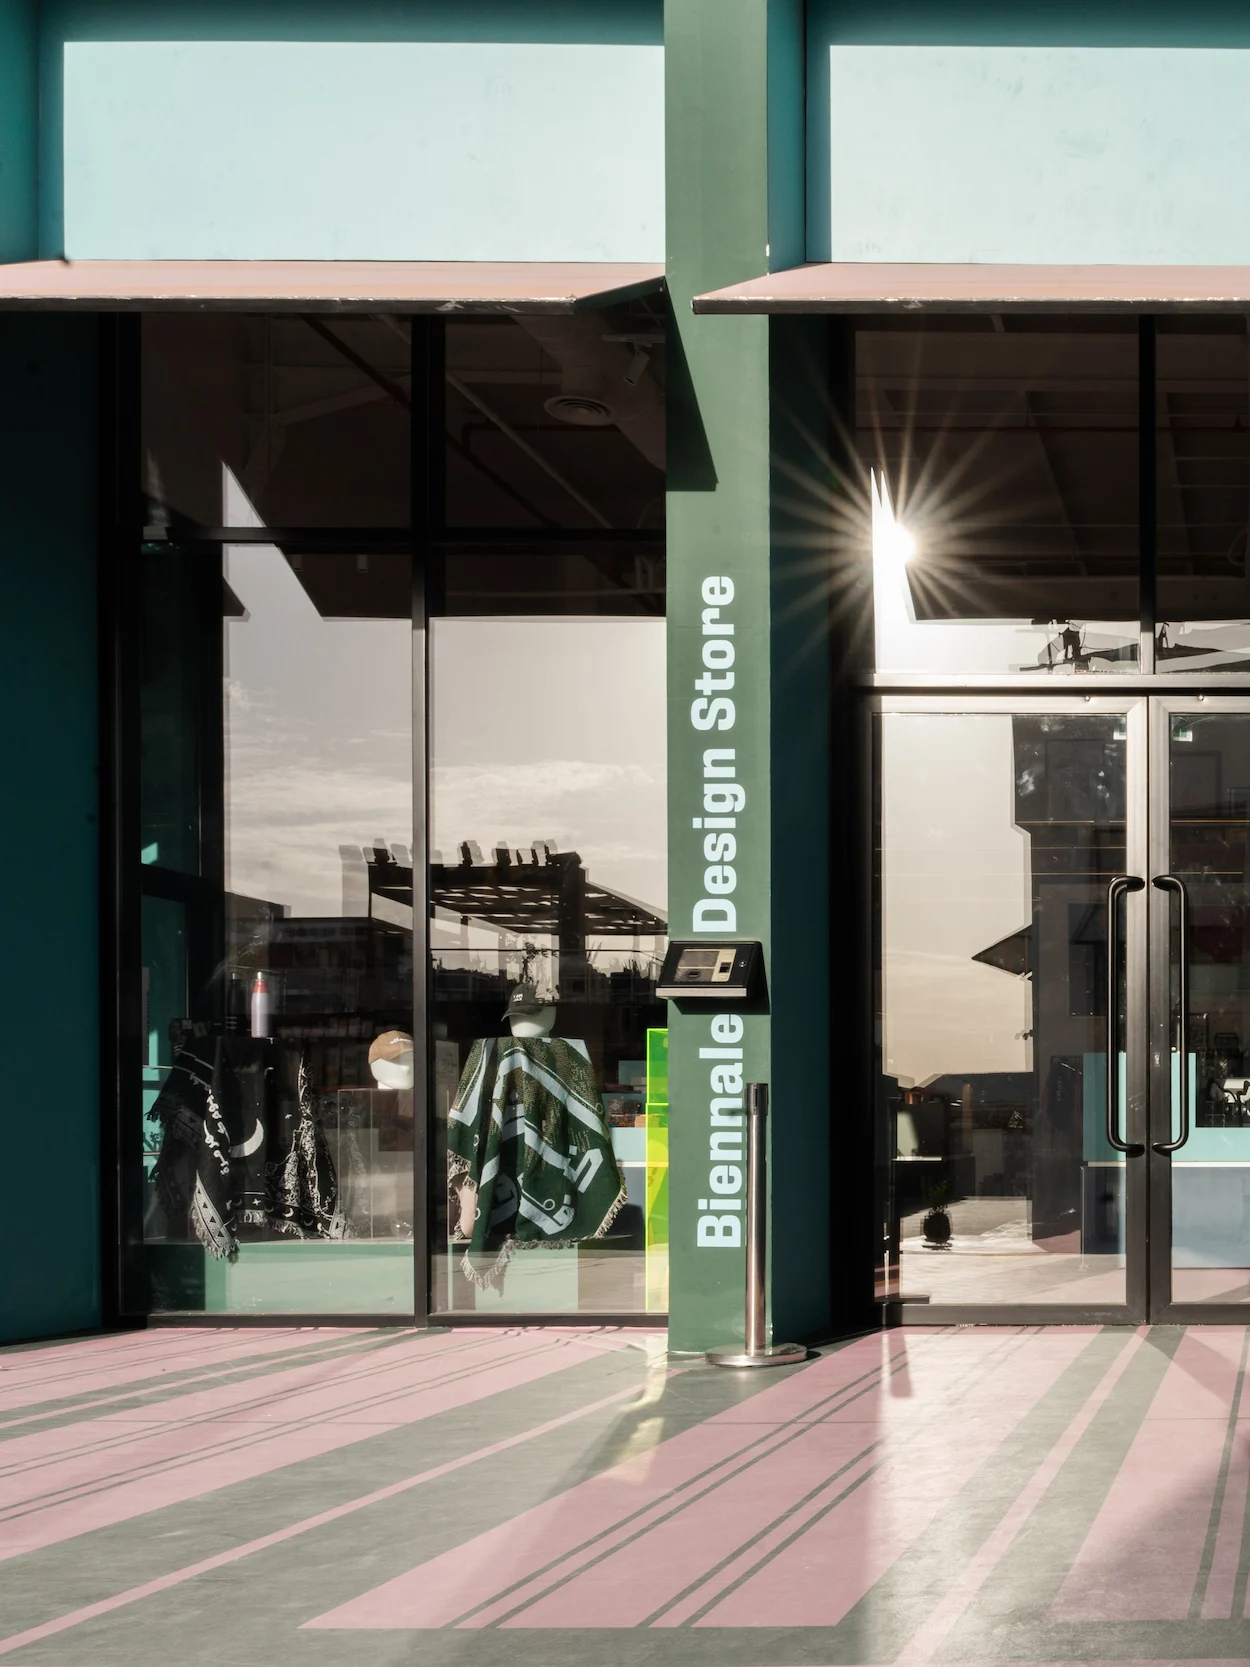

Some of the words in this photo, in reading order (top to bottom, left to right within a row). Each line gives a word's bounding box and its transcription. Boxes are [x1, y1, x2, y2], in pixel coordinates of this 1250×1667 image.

[690, 575, 736, 731] Store
[692, 748, 746, 933] Design
[697, 1014, 744, 1248] Biennale
